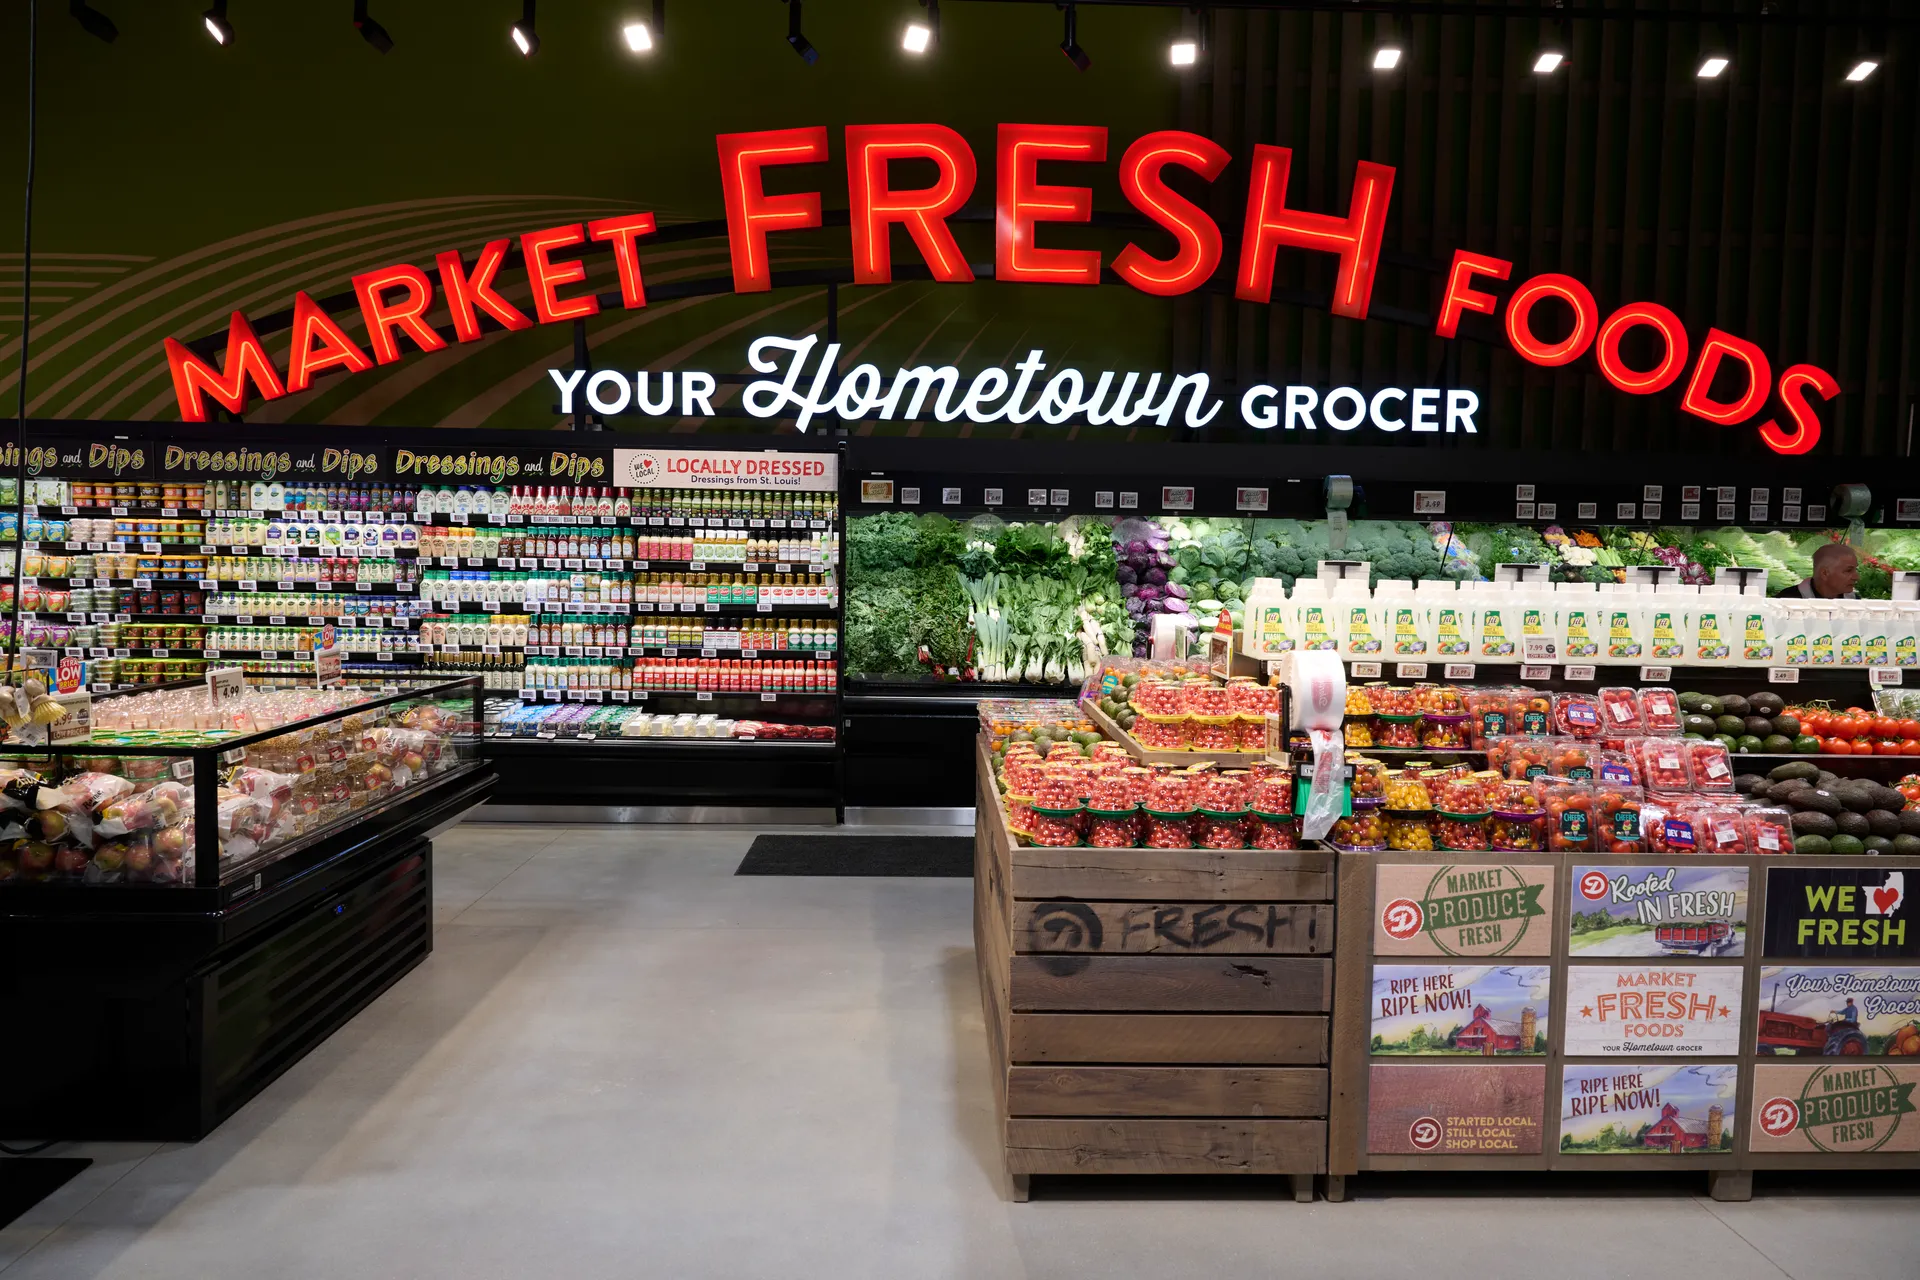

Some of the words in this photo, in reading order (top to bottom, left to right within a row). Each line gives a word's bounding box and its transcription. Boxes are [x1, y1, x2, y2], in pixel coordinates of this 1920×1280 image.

[163, 212, 656, 422] MARKET
[716, 123, 1396, 320] FRESH
[1436, 249, 1840, 455] FOODS
[548, 370, 715, 416] YOUR
[742, 333, 1224, 434] Hometown
[1241, 385, 1479, 434] GROCER
[62, 448, 82, 463] and
[89, 443, 145, 475] Dips
[164, 445, 291, 480] Dressings
[296, 453, 315, 469] and
[322, 448, 378, 480] Dips
[395, 449, 520, 483] Dressings
[524, 457, 543, 472] and
[549, 451, 604, 483] Dips
[634, 463, 644, 471] WE
[667, 458, 741, 475] LOCALLY
[746, 460, 824, 477] DRESSED
[635, 468, 654, 478] LOCAL
[691, 475, 734, 486] Dressings
[736, 476, 758, 485] from
[760, 476, 772, 485] St.
[774, 477, 801, 485] Louis!
[56, 665, 81, 682] LOW
[60, 659, 79, 669] EXTRA
[59, 679, 78, 689] PRICE
[223, 686, 239, 699] 4.99
[1484, 715, 1504, 723] CHEERS
[1525, 715, 1544, 723] CHEERS
[1564, 812, 1585, 821] CHEERS
[1615, 813, 1637, 821] CHEERS
[1447, 869, 1502, 893] MARKET
[1609, 867, 1676, 904] Rooted
[1428, 890, 1527, 926] PRODUCE
[1636, 896, 1662, 924] IN
[1668, 891, 1735, 918] FRESH
[1805, 886, 1856, 912] WE
[1459, 924, 1502, 947] FRESH
[1797, 919, 1906, 945] FRESH
[1390, 978, 1419, 995] RIPE
[1423, 974, 1455, 992] HERE
[1617, 972, 1697, 988] MARKET
[1786, 974, 1832, 999] Your
[1832, 974, 1920, 995] Hometown
[1381, 994, 1419, 1018] RIPE
[1425, 989, 1472, 1014] NOW!
[1597, 991, 1717, 1022] FRESH
[1864, 994, 1920, 1020] Grocer
[1624, 1023, 1684, 1038] FOODS
[1622, 1041, 1675, 1053] Hometown
[1580, 1077, 1609, 1094] RIPE
[1613, 1073, 1643, 1091] HERE
[1823, 1068, 1877, 1092] MARKET
[1571, 1094, 1608, 1117] RIPE
[1614, 1088, 1660, 1112] NOW!
[1804, 1089, 1900, 1124] PRODUCE
[1446, 1117, 1494, 1126] STARTED
[1497, 1117, 1537, 1126] LOCAL.
[1832, 1121, 1874, 1144] FRESH
[1446, 1128, 1474, 1138] STILL
[1476, 1128, 1515, 1138] LOCAL.
[1446, 1140, 1477, 1149] SHOP
[1479, 1140, 1518, 1149] LOCAL.
